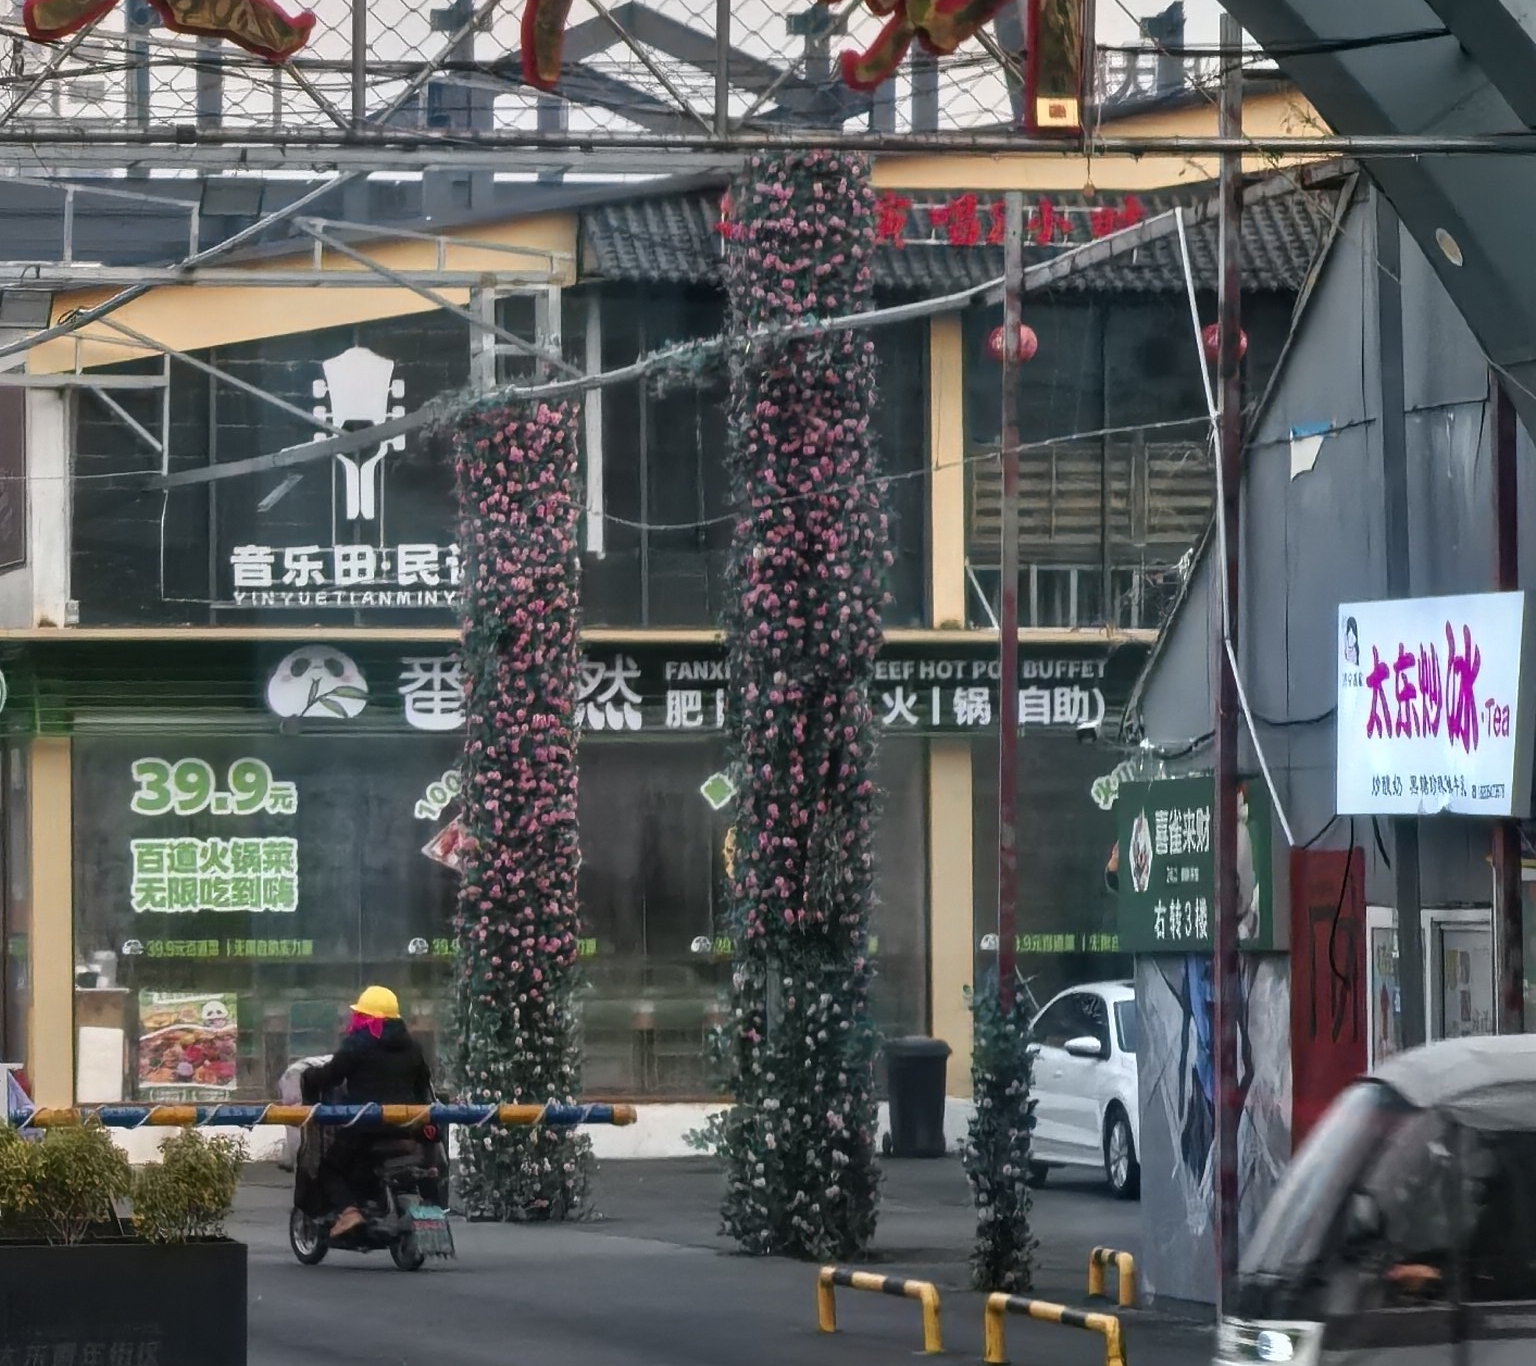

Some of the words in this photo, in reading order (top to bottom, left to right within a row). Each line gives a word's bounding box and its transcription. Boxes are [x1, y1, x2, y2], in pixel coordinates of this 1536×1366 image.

[875, 660, 914, 680] EEF
[919, 660, 966, 680] HOT
[972, 660, 1002, 680] PO
[1023, 659, 1108, 679] BUFFET
[130, 757, 298, 815] 39.9元
[130, 837, 298, 875] 百道火锅菜
[130, 874, 298, 912] 无限吃到嗨
